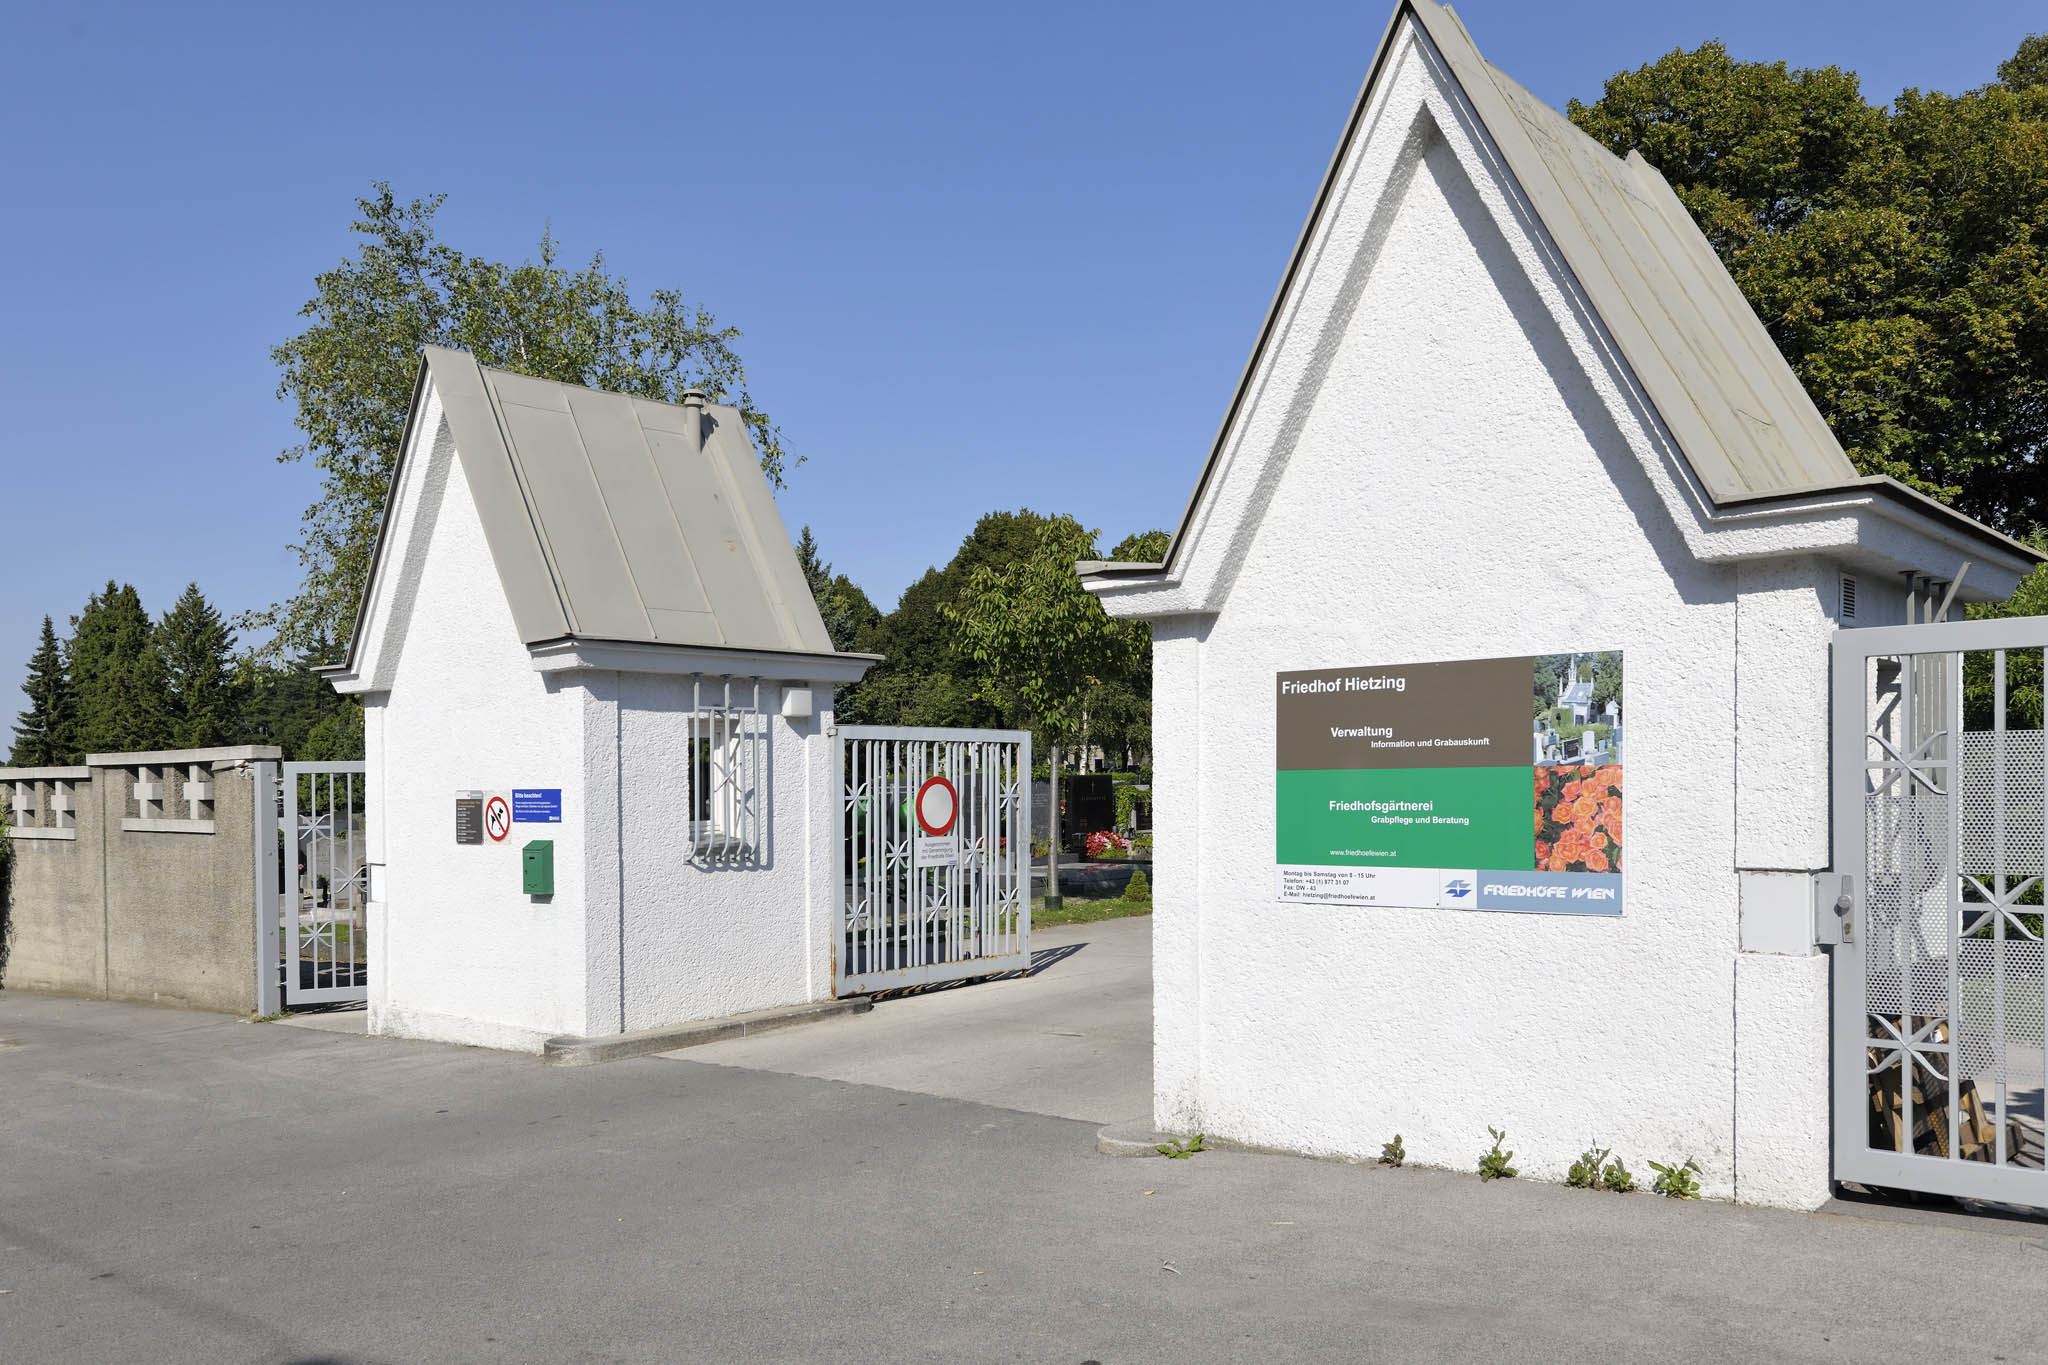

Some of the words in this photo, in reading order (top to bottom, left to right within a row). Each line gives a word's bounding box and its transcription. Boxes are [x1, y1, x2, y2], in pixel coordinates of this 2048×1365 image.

[1282, 678, 1342, 694] Friedhof
[1345, 676, 1406, 692] Hietzing
[1330, 726, 1393, 738] Verwaltung
[1370, 740, 1415, 748] Information
[1416, 739, 1432, 747] und
[1434, 737, 1490, 746] Grabauskunft
[1329, 800, 1433, 813] Friedhofsgärtnerei
[1370, 816, 1413, 825] Grabpflege
[1415, 816, 1430, 824] und
[1432, 816, 1470, 826] Beratung
[1330, 849, 1397, 857] www.friedhoefewien.at
[1483, 884, 1568, 898] FRIEDHÖFE
[1571, 887, 1615, 900] WIEN
